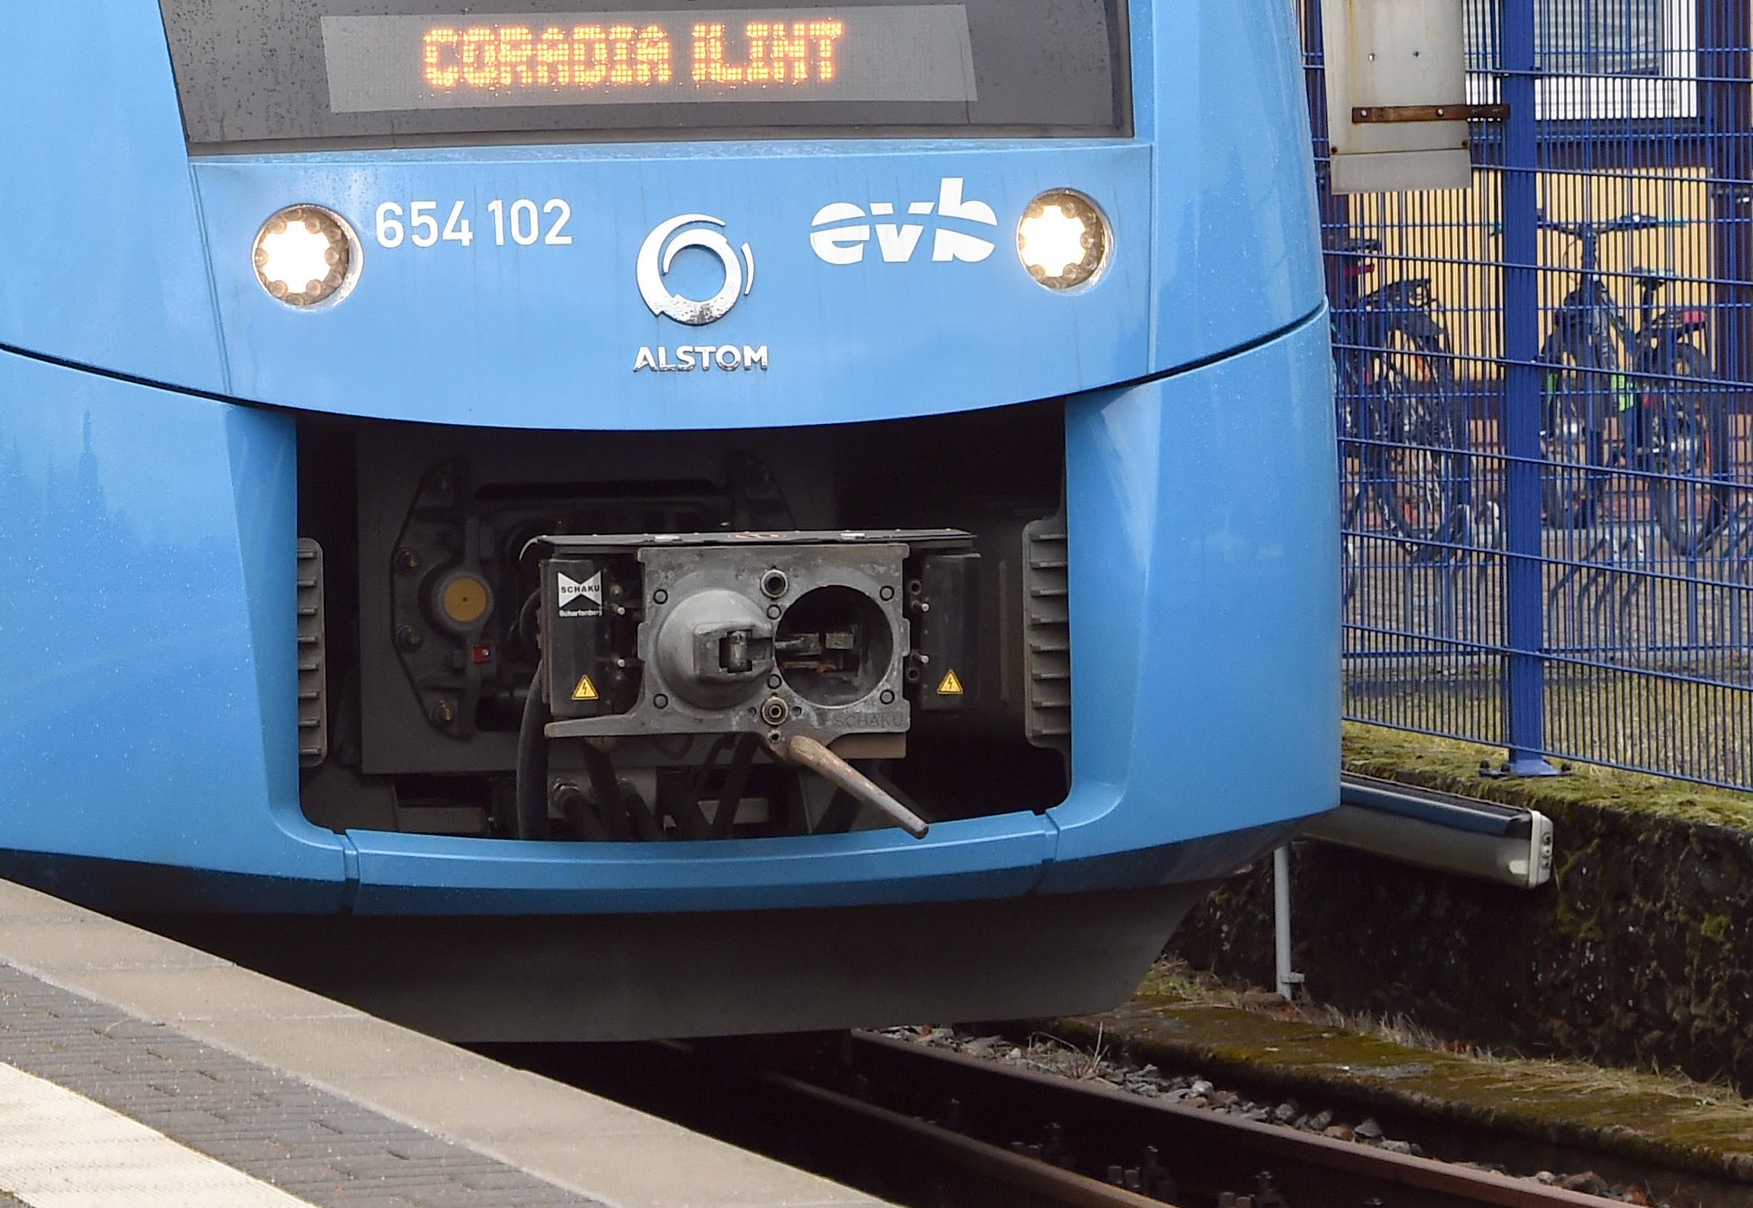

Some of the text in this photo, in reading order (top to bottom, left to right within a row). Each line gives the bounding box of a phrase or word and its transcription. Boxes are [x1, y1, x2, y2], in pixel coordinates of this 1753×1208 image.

[422, 23, 671, 87] CORADIA
[376, 198, 573, 248] 654 102
[809, 177, 998, 264] evb
[633, 345, 769, 372] ALSTOM
[560, 585, 600, 594] SCHAKU
[832, 713, 904, 728] SCHAKU
